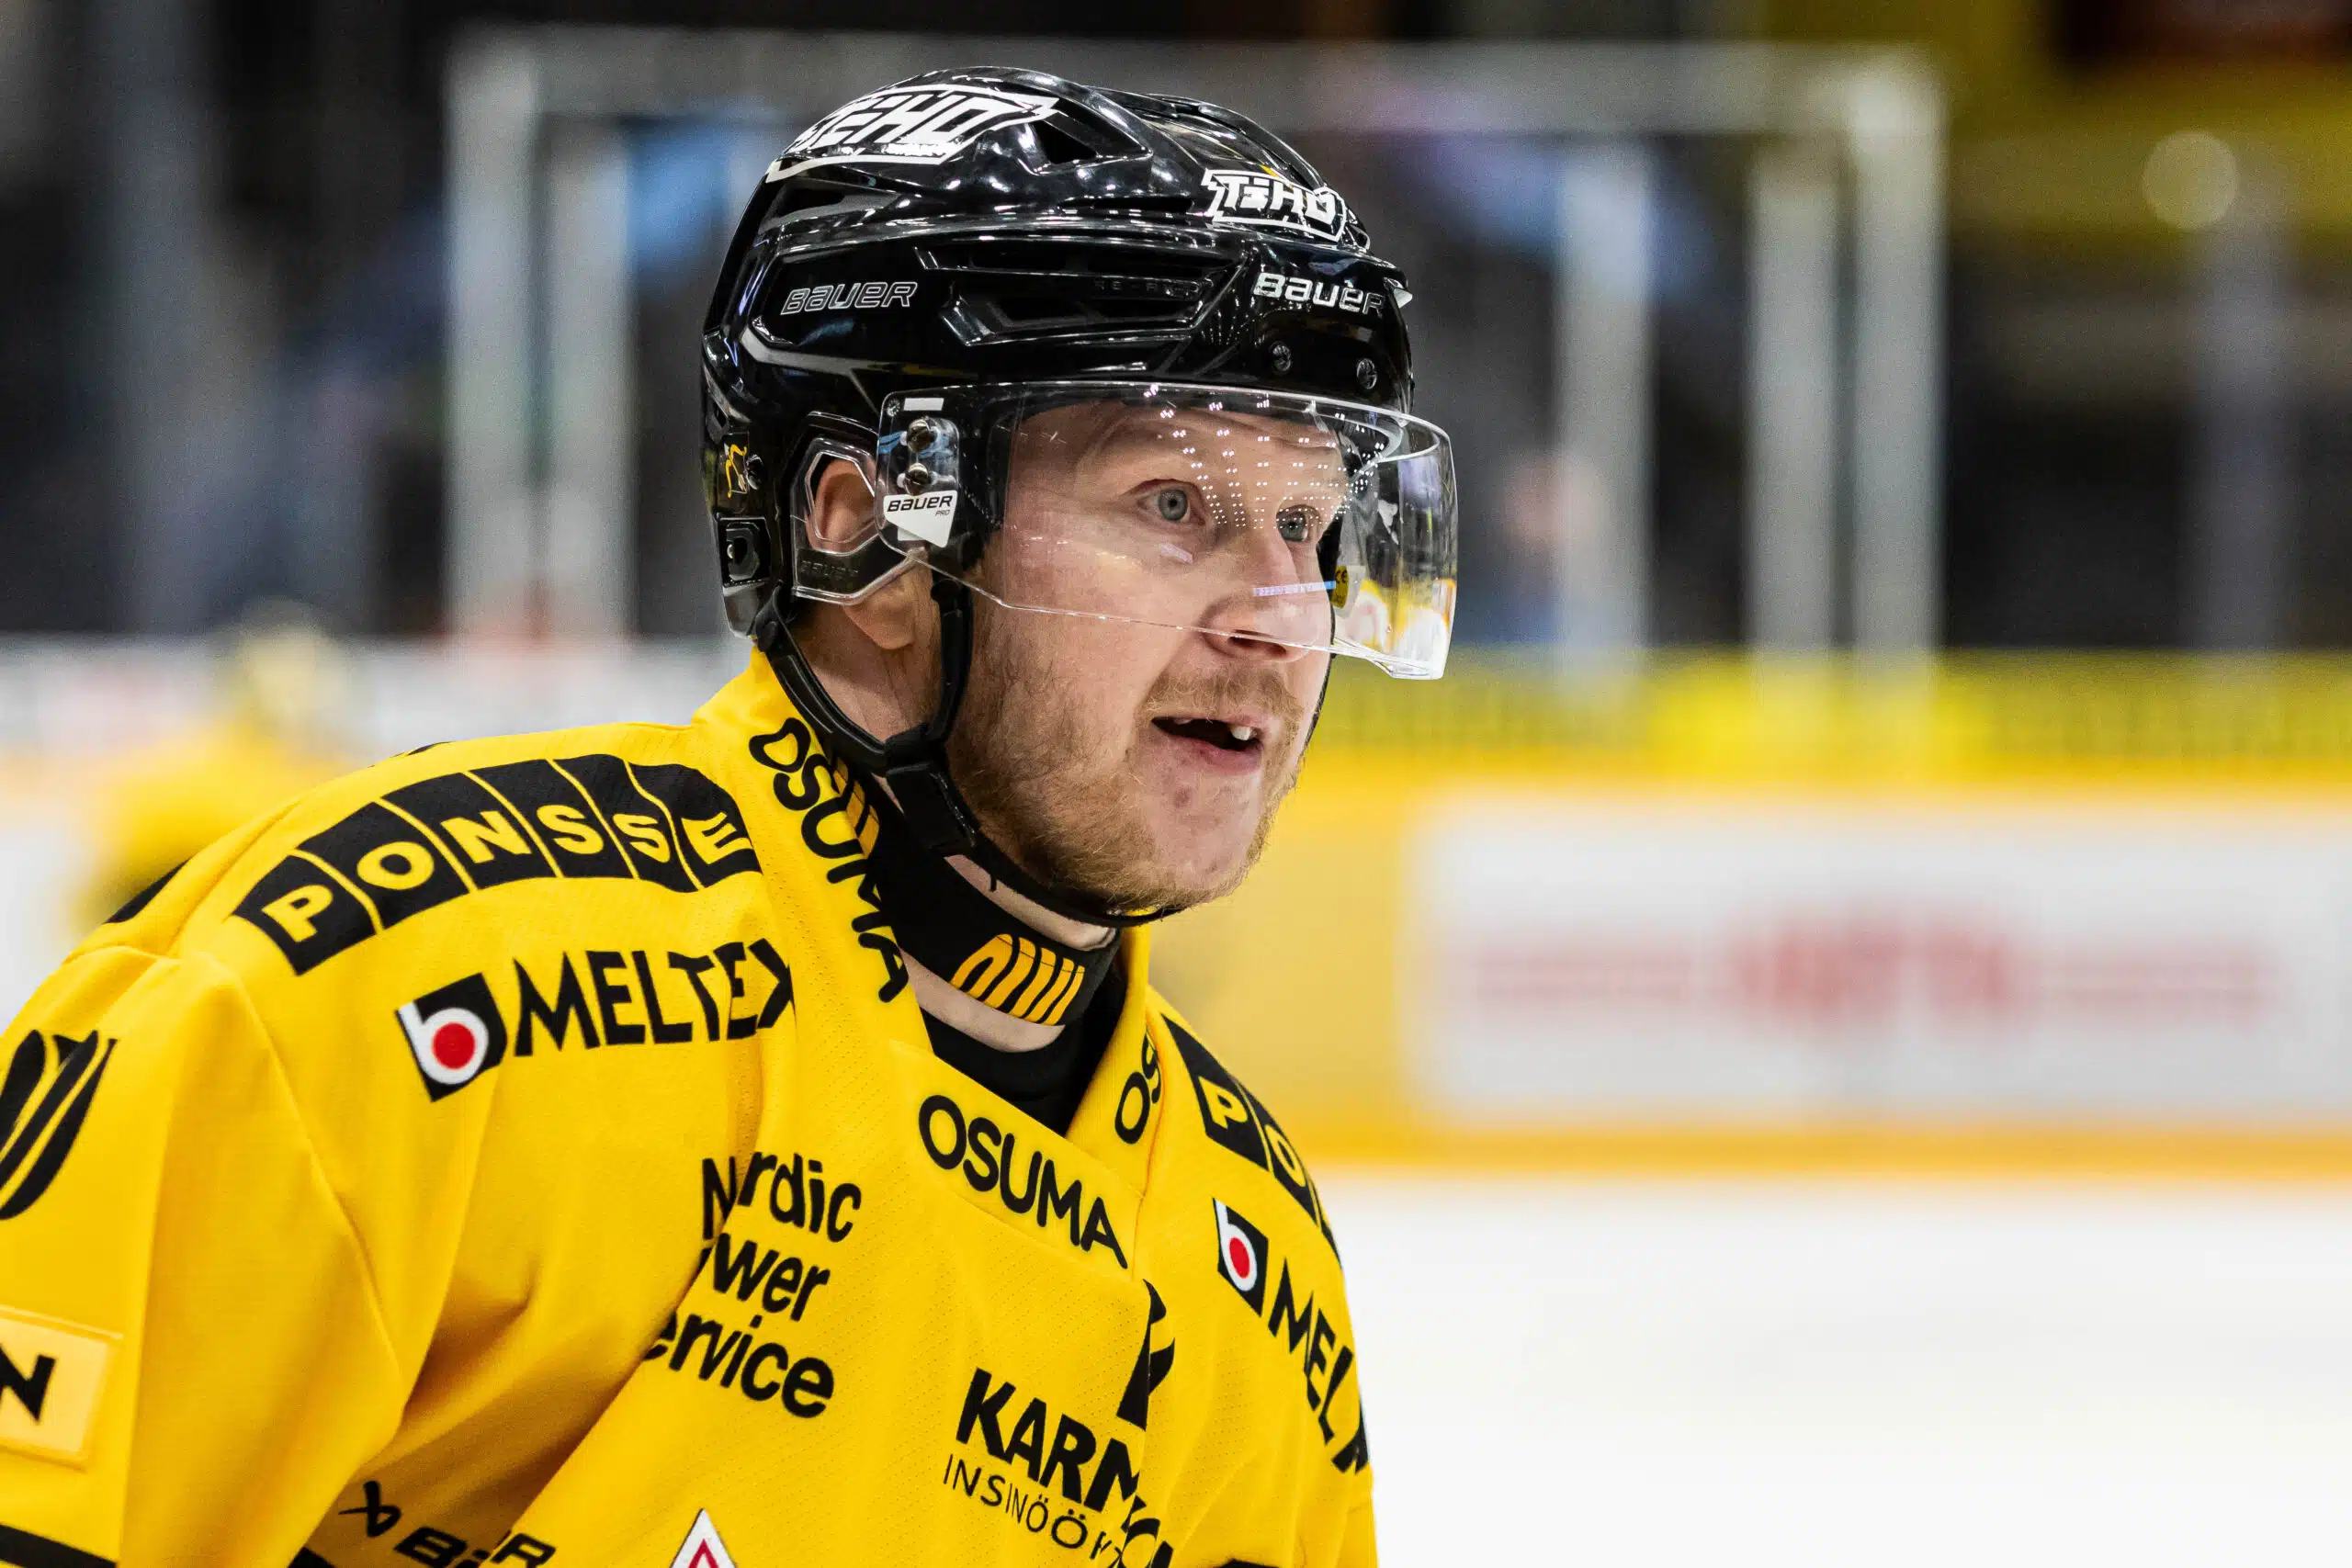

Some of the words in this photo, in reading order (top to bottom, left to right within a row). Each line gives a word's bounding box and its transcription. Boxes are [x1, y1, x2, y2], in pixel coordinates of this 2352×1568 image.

[1214, 175, 1337, 225] TEHO
[780, 282, 918, 315] BAUER
[1252, 272, 1386, 318] BAUER
[887, 495, 953, 513] BAUER
[934, 509, 951, 517] PRO
[261, 804, 753, 943] PONSSE
[702, 1152, 862, 1243] Nrdic
[919, 1095, 1128, 1269] OSUMA
